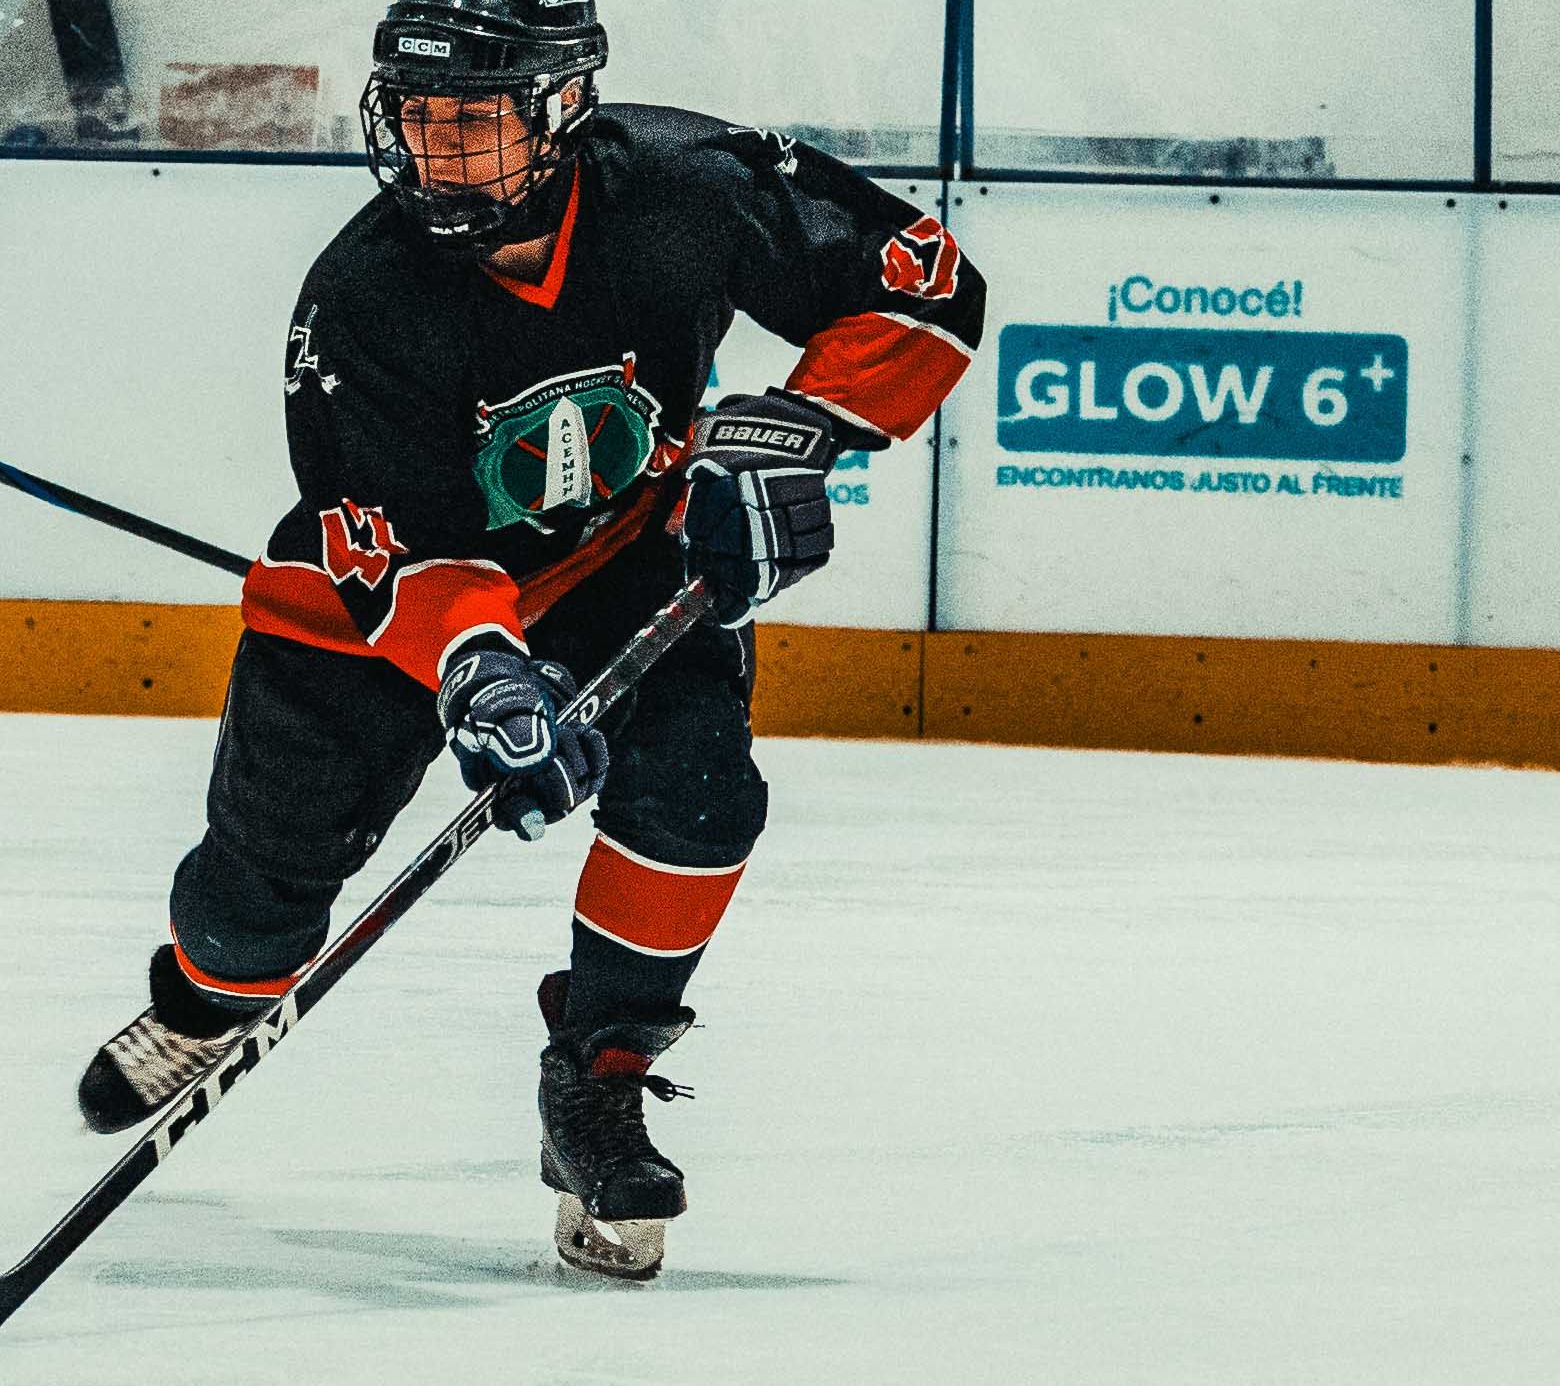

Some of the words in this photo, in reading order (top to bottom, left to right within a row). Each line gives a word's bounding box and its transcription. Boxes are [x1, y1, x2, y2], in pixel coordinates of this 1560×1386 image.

[400, 38, 449, 56] CCM
[999, 359, 1273, 424] GLOW
[716, 425, 805, 449] BAUER
[996, 465, 1186, 493] ENCONTRANOS
[1192, 469, 1271, 495] JUSTO
[1277, 471, 1307, 496] AL
[1311, 472, 1403, 498] FRENTE
